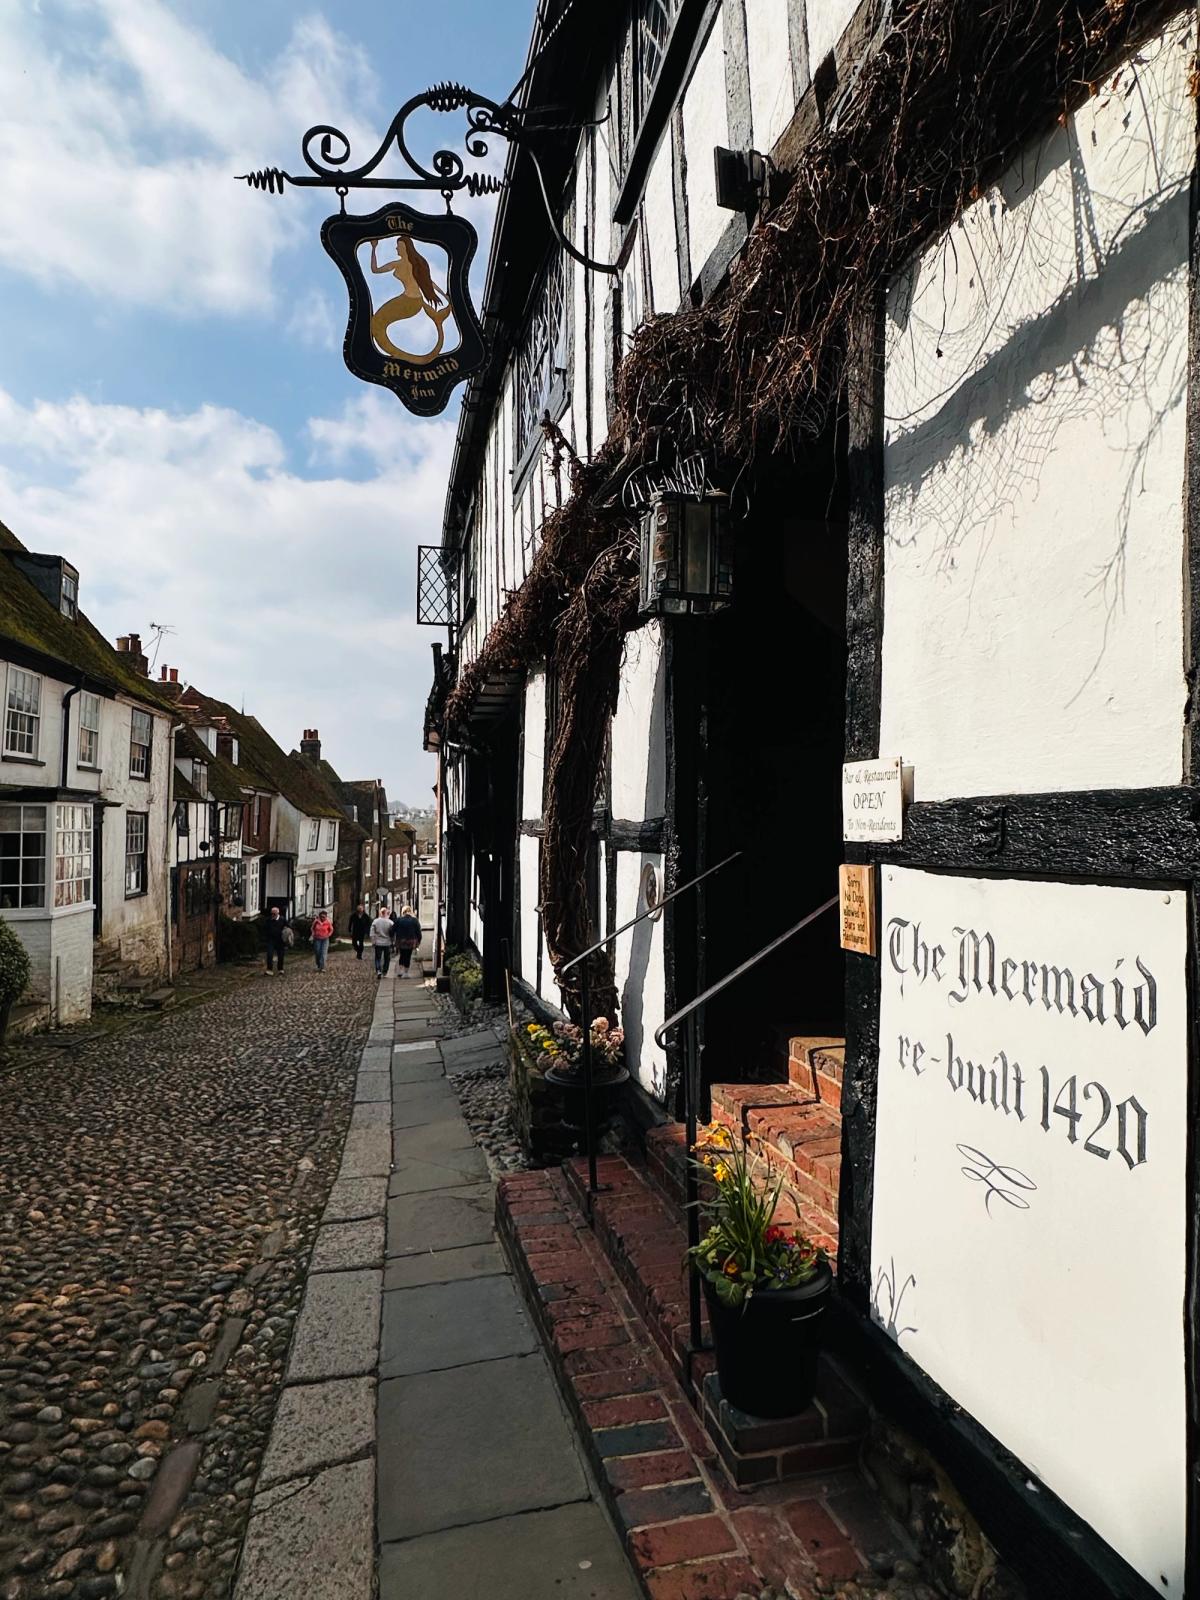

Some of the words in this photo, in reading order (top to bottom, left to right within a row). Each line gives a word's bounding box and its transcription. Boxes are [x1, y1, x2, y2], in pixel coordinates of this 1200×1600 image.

[385, 215, 414, 231] The
[382, 357, 460, 382] Mermaid
[410, 384, 436, 401] Inn
[864, 769, 898, 785] Restaurant
[853, 791, 886, 809] OPEN
[848, 818, 854, 831] To
[855, 816, 896, 832] Non-Residents
[847, 875, 861, 892] Sorry
[844, 889, 851, 902] No
[852, 890, 864, 907] Dogs
[844, 917, 855, 931] Bars
[887, 917, 946, 1000] The
[948, 926, 1158, 1037] Mermaid
[898, 1032, 1027, 1122] re-built
[1038, 1064, 1149, 1171] 1420
